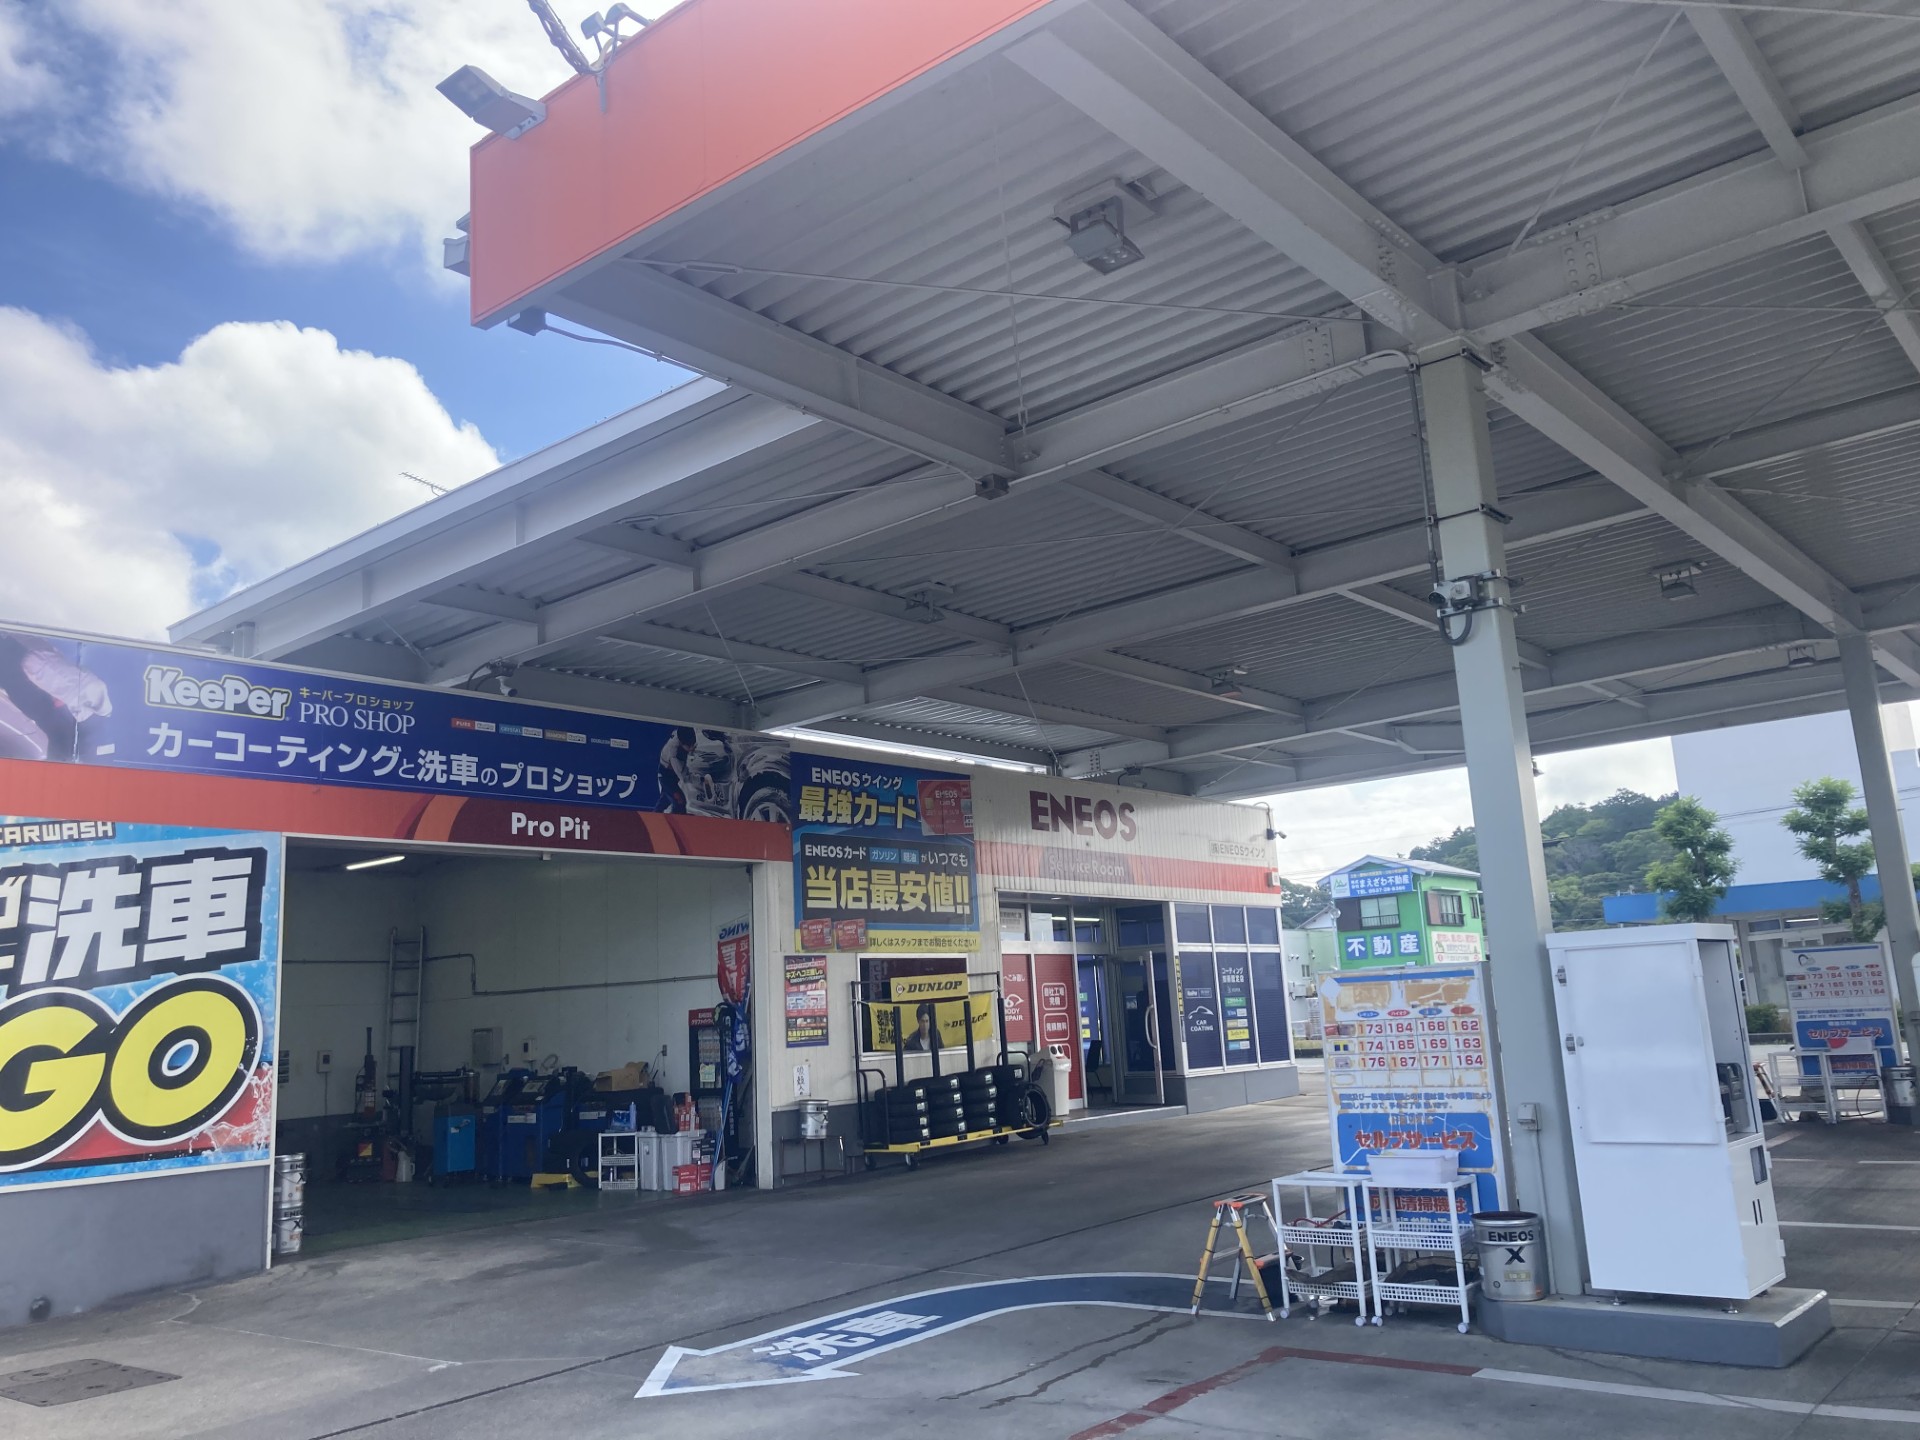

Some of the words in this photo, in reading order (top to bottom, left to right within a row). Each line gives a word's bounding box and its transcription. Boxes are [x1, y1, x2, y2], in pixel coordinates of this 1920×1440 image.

[146, 666, 290, 719] KeePer
[300, 702, 348, 728] PRO
[354, 709, 416, 735] SHOP
[148, 722, 638, 799] カーコーティングと洗車のプロショップ
[799, 785, 917, 829] 最強カード
[1029, 790, 1137, 842] ENEOS
[511, 812, 555, 838] Pro
[560, 817, 591, 841] Pit
[871, 850, 898, 861] ガソリン
[1092, 860, 1125, 877] Room
[1347, 933, 1420, 958] 不動産
[907, 981, 962, 993] DUNLOP
[951, 1012, 988, 1028] DULOP
[1359, 1022, 1383, 1034] 173
[1388, 1022, 1413, 1034] 184
[1420, 1020, 1445, 1032] 168
[1453, 1019, 1479, 1031] 162
[1808, 1028, 1884, 1039] セルフサービス
[1359, 1040, 1384, 1051] 174
[1389, 1039, 1415, 1050] 185
[1422, 1038, 1447, 1049] 169
[1455, 1037, 1481, 1048] 163
[1361, 1056, 1386, 1068] 176
[1391, 1056, 1416, 1067] 187
[1423, 1055, 1448, 1066] 171
[1457, 1054, 1483, 1066] 164
[1355, 1130, 1479, 1150] セルフサービス
[1488, 1230, 1534, 1242] ENEOS
[1504, 1246, 1526, 1265] X
[752, 1310, 943, 1361] 洗車
